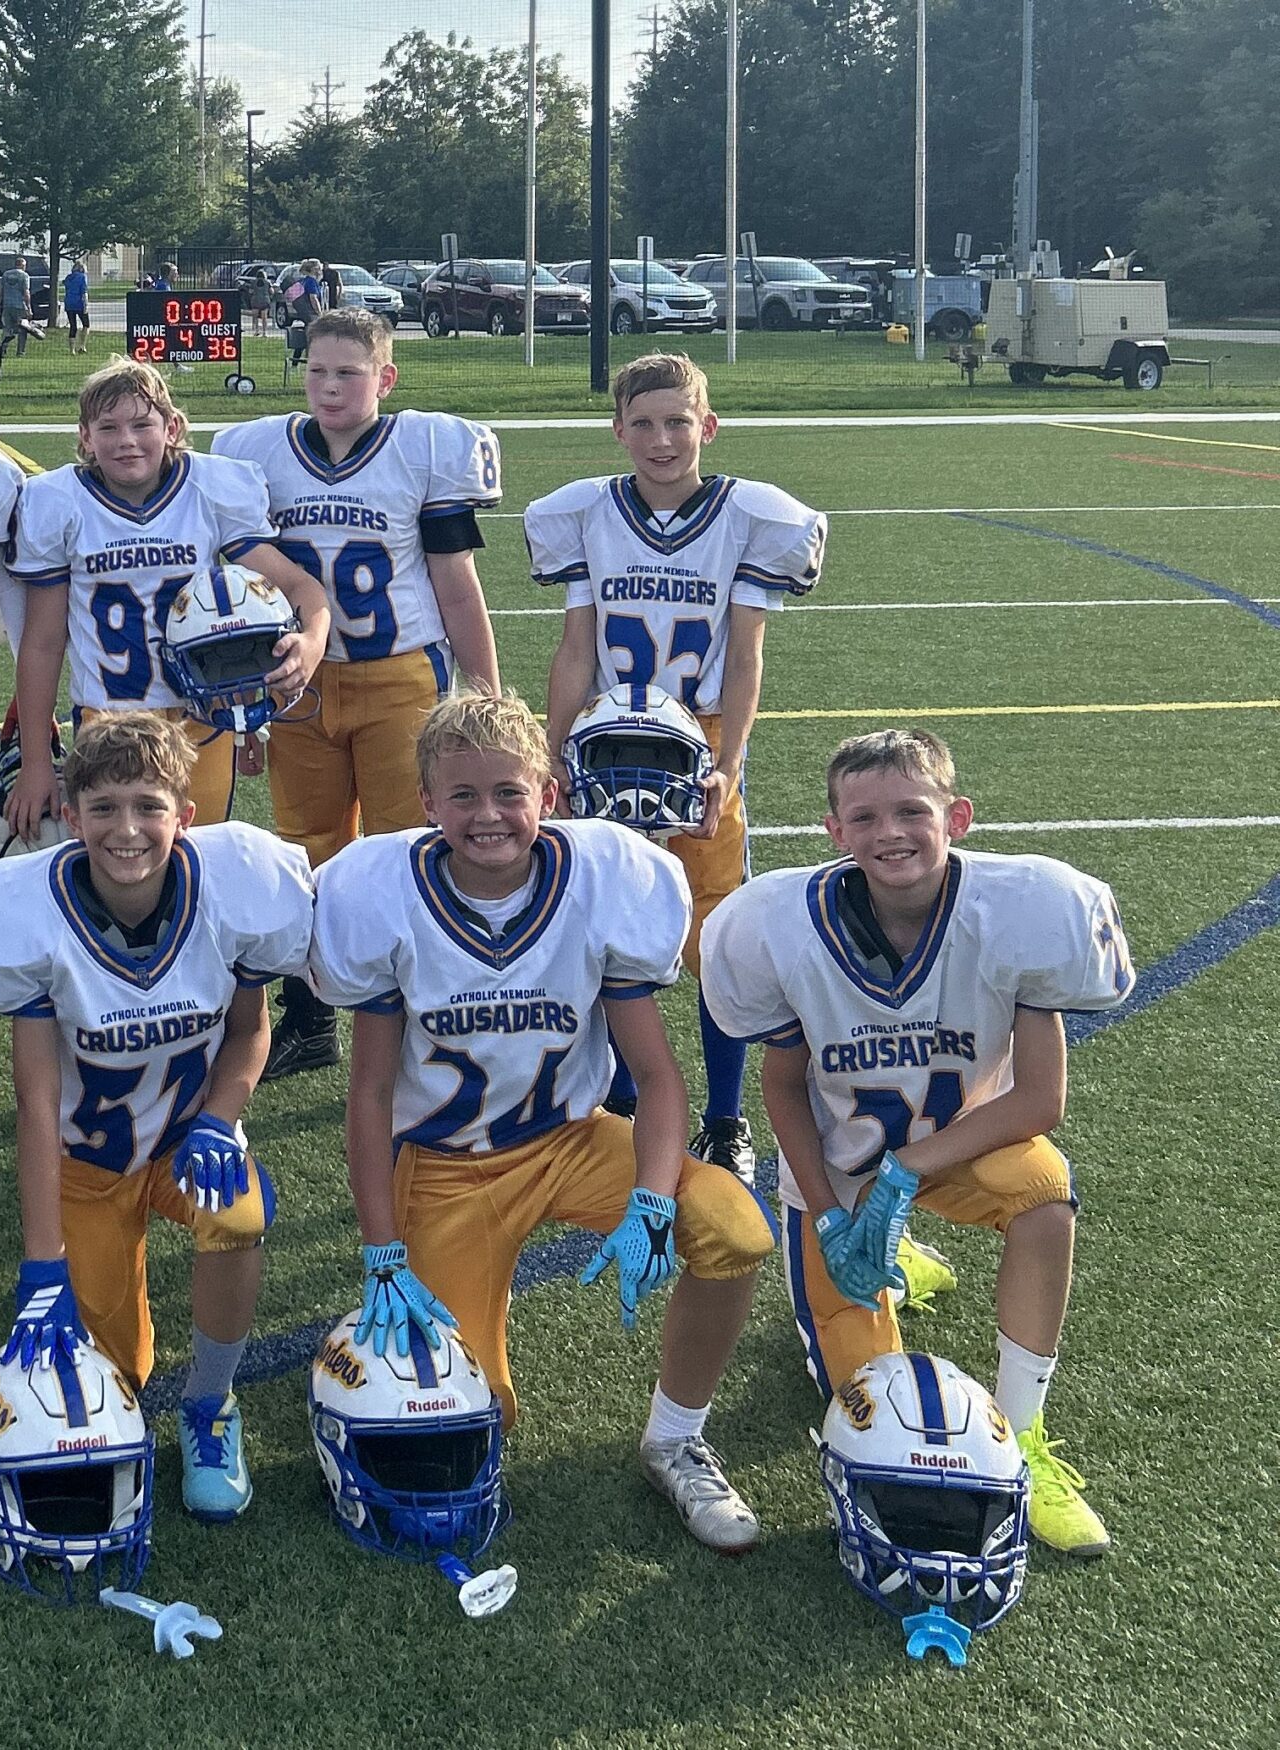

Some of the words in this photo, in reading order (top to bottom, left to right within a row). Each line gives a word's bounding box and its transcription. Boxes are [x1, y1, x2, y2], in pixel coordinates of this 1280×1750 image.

[166, 300, 222, 323] 0:00
[133, 325, 166, 337] HOME
[179, 329, 193, 348] 4
[201, 324, 237, 336] GUEST
[135, 338, 165, 360] 22
[170, 351, 204, 361] PERIOD
[208, 338, 236, 359] 36
[295, 495, 325, 505] CATHOLIC
[327, 494, 364, 505] MEMORIAL
[105, 538, 137, 549] CATHOLIC
[138, 537, 174, 545] MEMORIAL
[85, 544, 197, 574] CRUSADERS
[626, 565, 661, 574] CATHOLIC
[600, 576, 717, 606] CRUSADERS
[210, 618, 247, 633] Riddell
[450, 990, 498, 1004] CATHOLIC
[499, 988, 547, 1000] MEMORIAL
[100, 1007, 146, 1025] CATHOLIC
[148, 1000, 199, 1018] MEMORIAL
[420, 1001, 578, 1037] CRUSADERS
[76, 1006, 223, 1052] CRUSADERS
[851, 1024, 899, 1037] CATHOLIC
[394, 1042, 576, 1155] 24
[407, 1400, 457, 1414] Riddell
[57, 1434, 108, 1453] Riddell
[910, 1452, 968, 1470] Riddell
